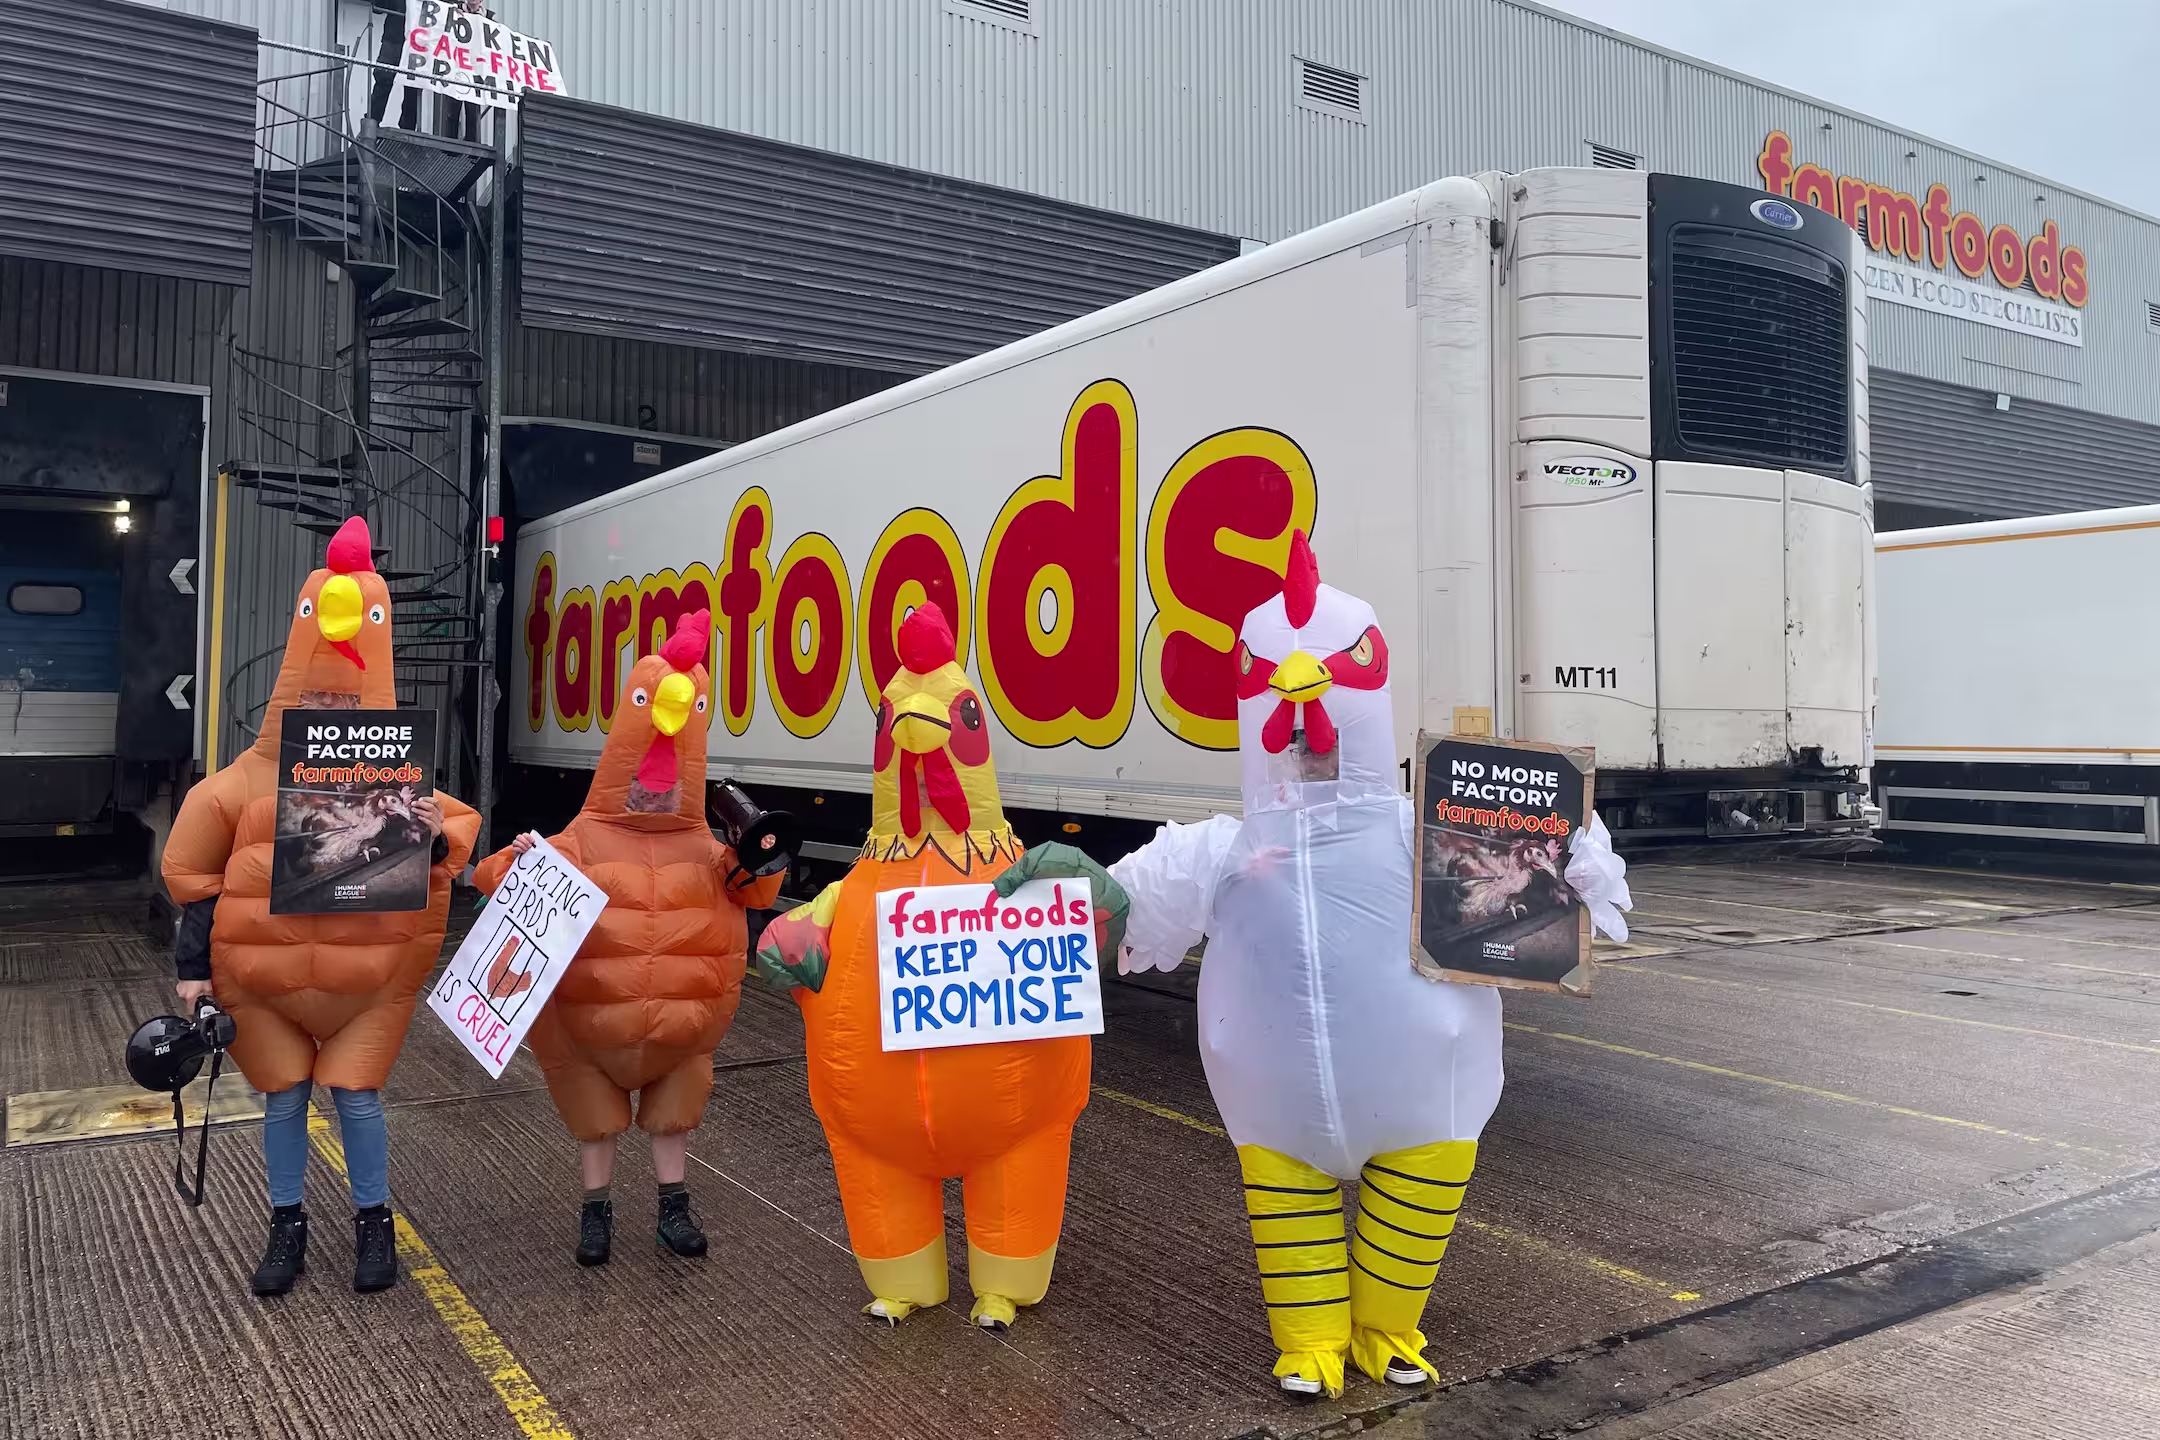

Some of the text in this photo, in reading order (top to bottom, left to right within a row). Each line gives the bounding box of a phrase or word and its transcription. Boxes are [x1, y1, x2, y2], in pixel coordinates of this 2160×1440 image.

[418, 0, 553, 72] BROKEN
[409, 27, 557, 92] CAE-FREE
[1757, 130, 2089, 308] farmfoods
[1764, 206, 1793, 222] Carrier
[1911, 276, 1967, 309] FOOD
[1970, 291, 2080, 338] SPECIALISTS
[638, 405, 658, 432] 2
[1543, 464, 1627, 479] VECTOR
[1564, 476, 1587, 485] 1950
[1555, 666, 1617, 688] MT11
[307, 725, 413, 741] NO MORE
[307, 744, 412, 759] FACTORY
[292, 762, 423, 784] farmfoods
[1451, 759, 1559, 789] NO MORE
[1451, 780, 1558, 808] FACTORY
[1436, 798, 1570, 837] farmfoods
[517, 844, 590, 919] CAGING
[496, 872, 557, 937] BIRDS
[888, 883, 1089, 938] farmfoods
[895, 933, 1092, 978] KEEP YOUR
[436, 970, 512, 1067] IS CRUEL
[892, 974, 1084, 1034] PROMISE
